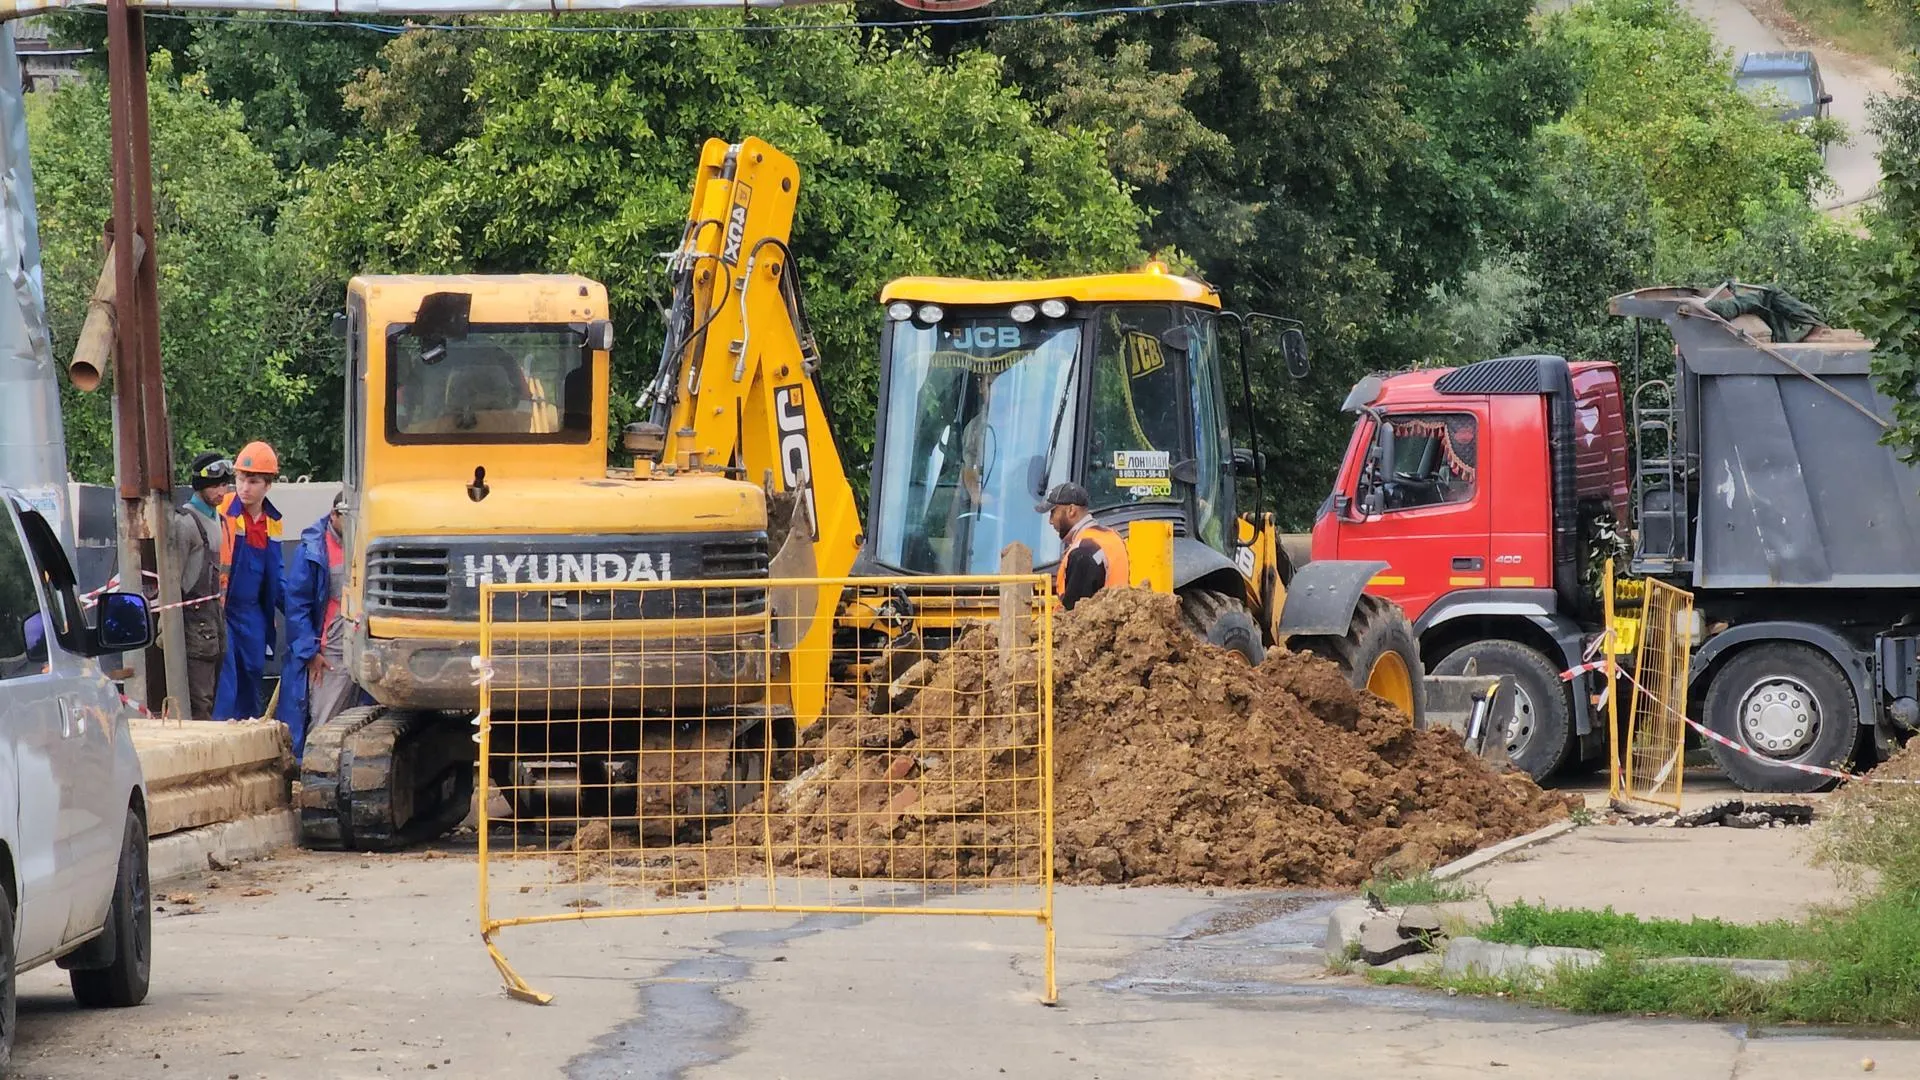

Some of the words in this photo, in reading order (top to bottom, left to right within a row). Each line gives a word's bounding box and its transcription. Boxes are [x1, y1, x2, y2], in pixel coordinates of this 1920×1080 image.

[953, 326, 1021, 349] JCB
[1130, 335, 1161, 374] JCB
[464, 553, 672, 588] HYUNDAI
[1495, 555, 1522, 564] 400
